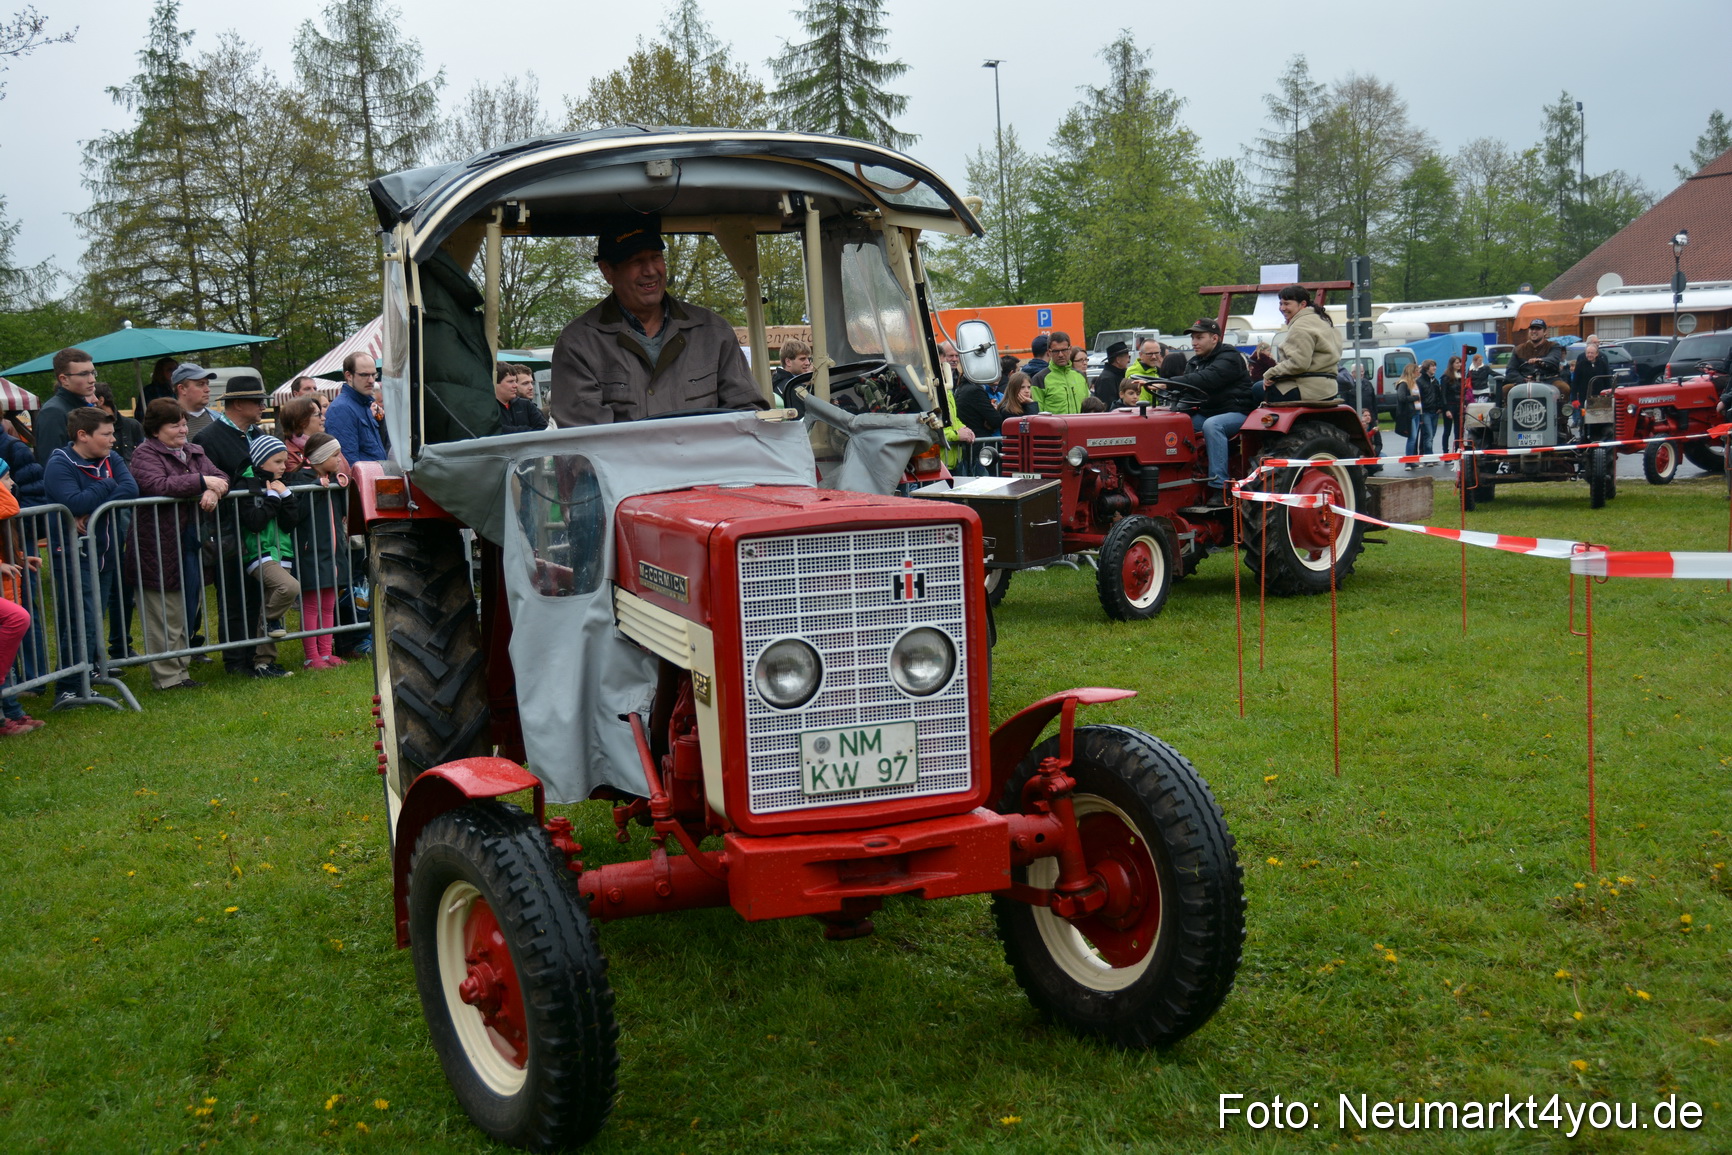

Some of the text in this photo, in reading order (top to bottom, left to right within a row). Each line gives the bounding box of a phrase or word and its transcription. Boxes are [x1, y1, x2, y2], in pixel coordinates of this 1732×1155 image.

[1040, 311, 1048, 326] P
[839, 728, 882, 758] NM
[811, 755, 908, 791] KW 97
